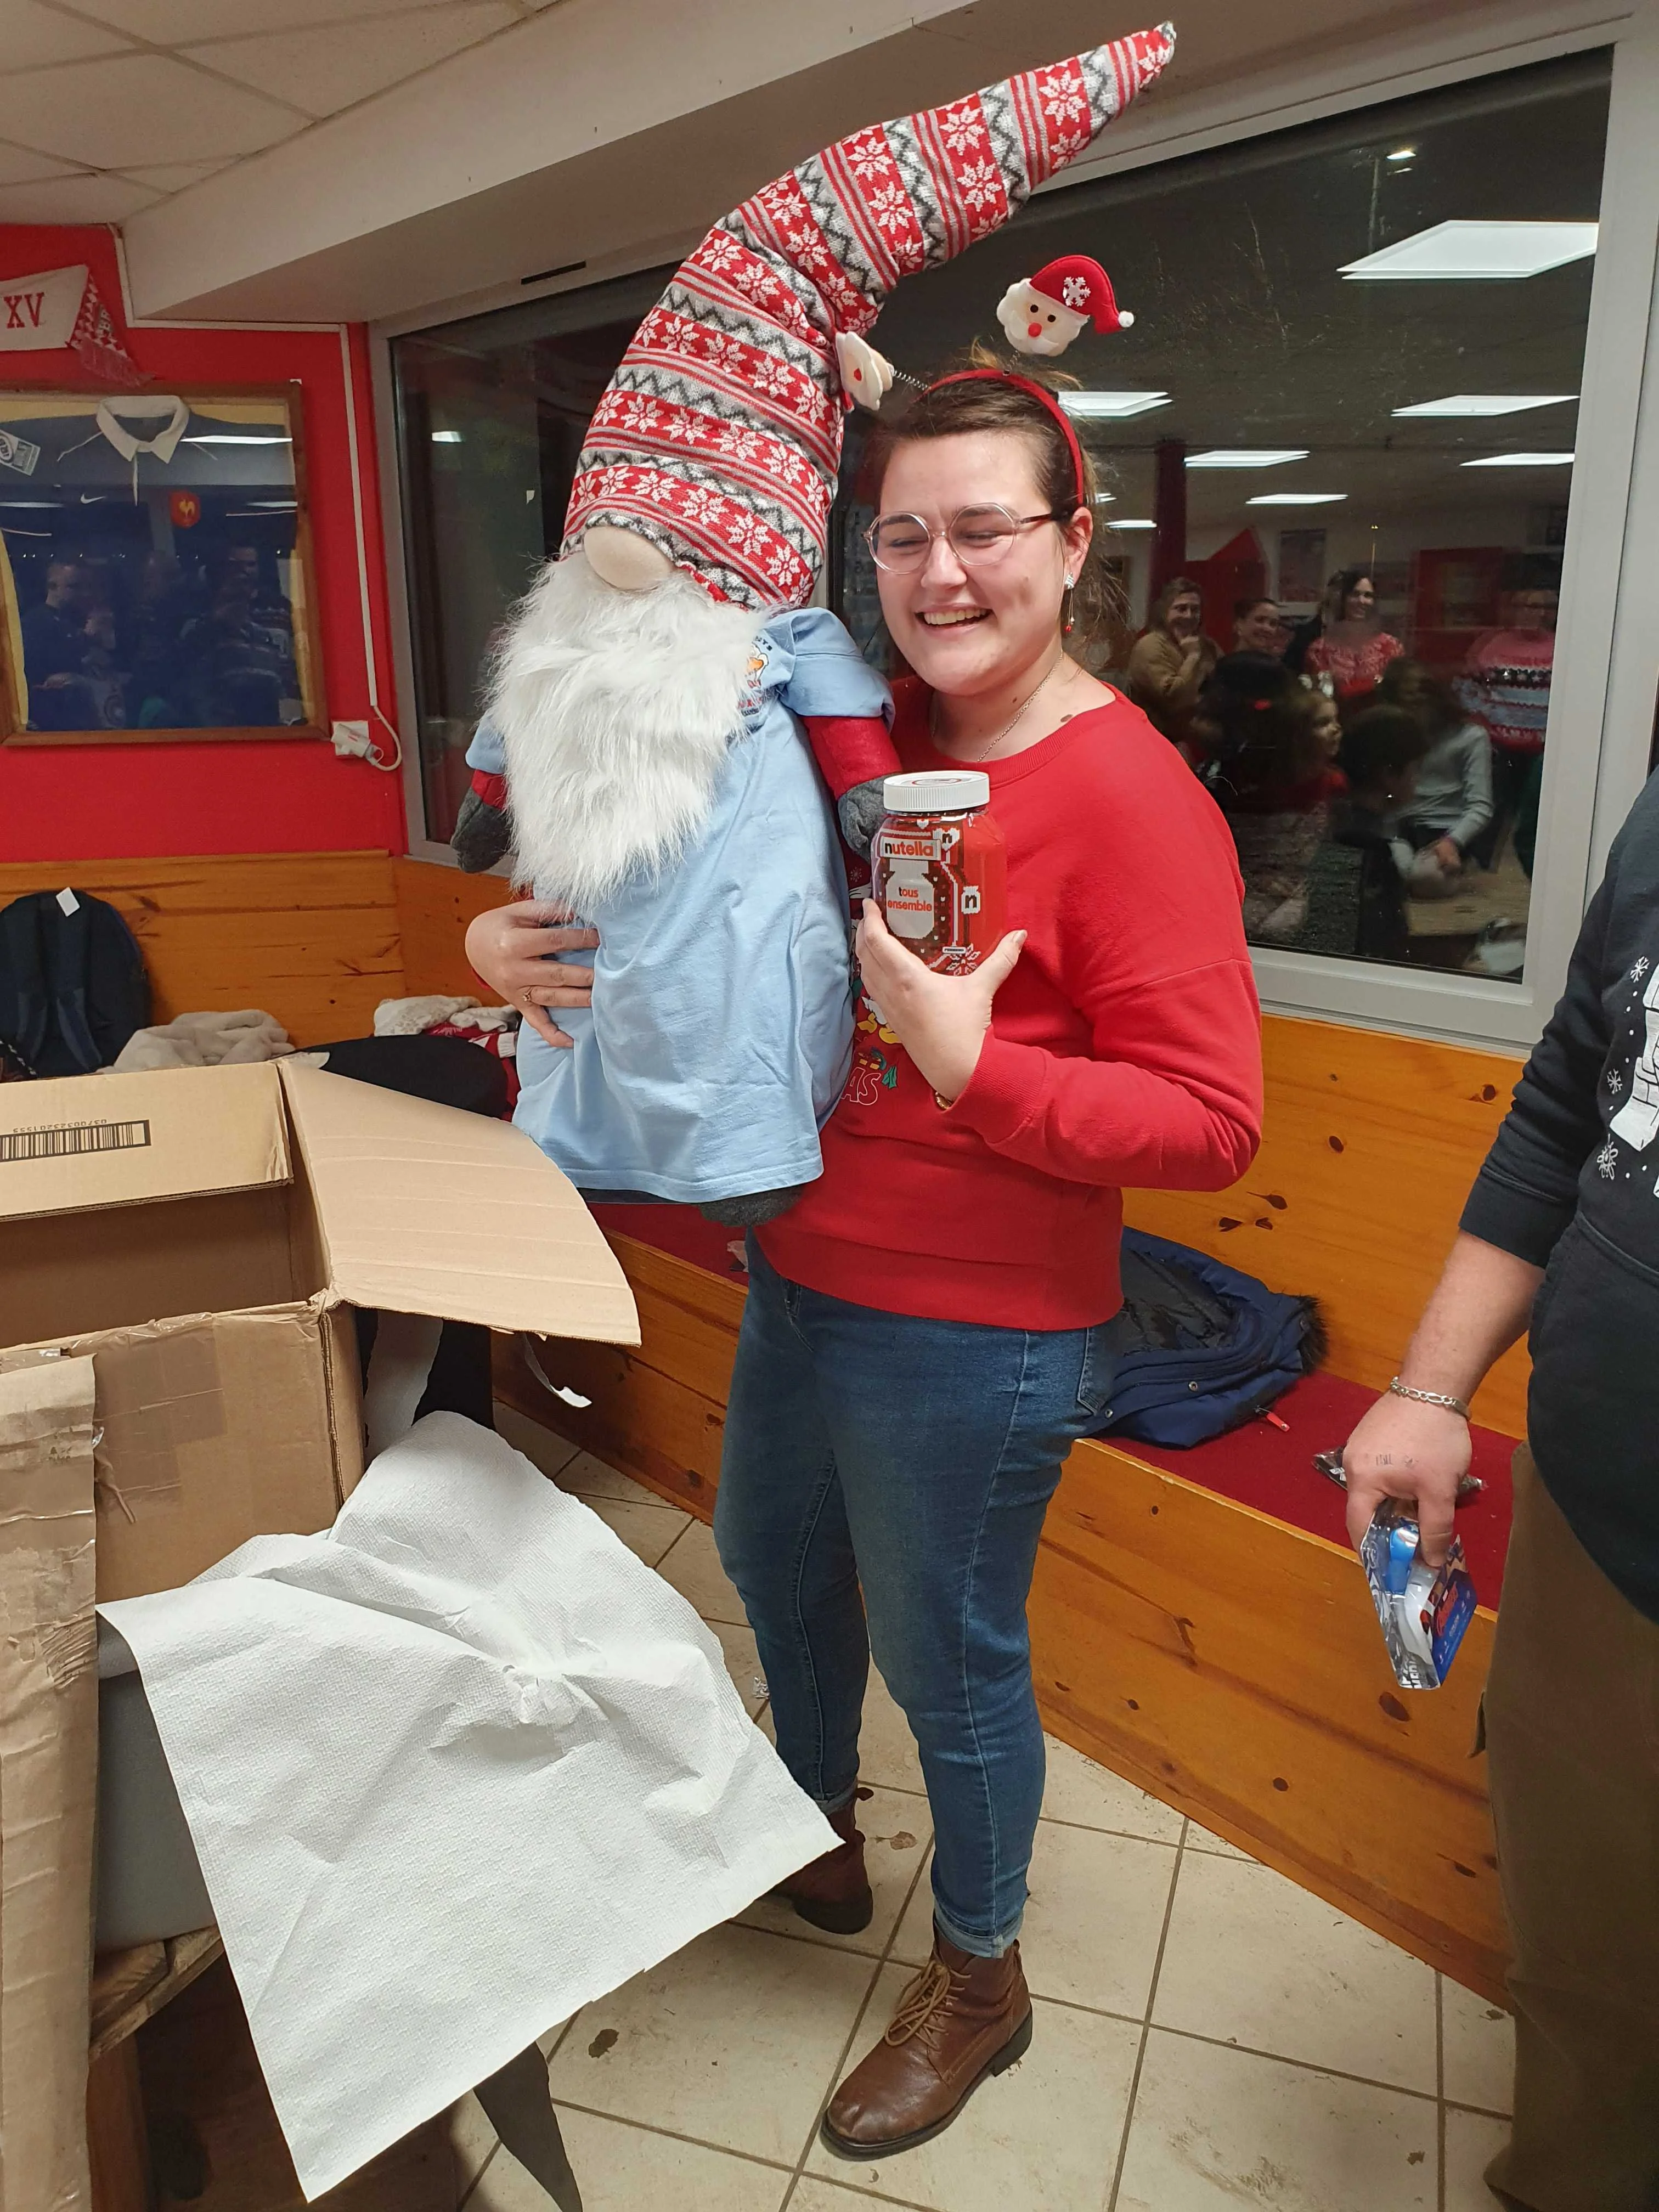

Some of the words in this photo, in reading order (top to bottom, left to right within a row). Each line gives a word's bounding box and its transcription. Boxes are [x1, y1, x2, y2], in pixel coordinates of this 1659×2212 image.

[3, 292, 45, 329] XV
[884, 841, 934, 856] nutella
[898, 886, 919, 898] tous
[887, 900, 933, 912] ensemble
[964, 894, 977, 909] n
